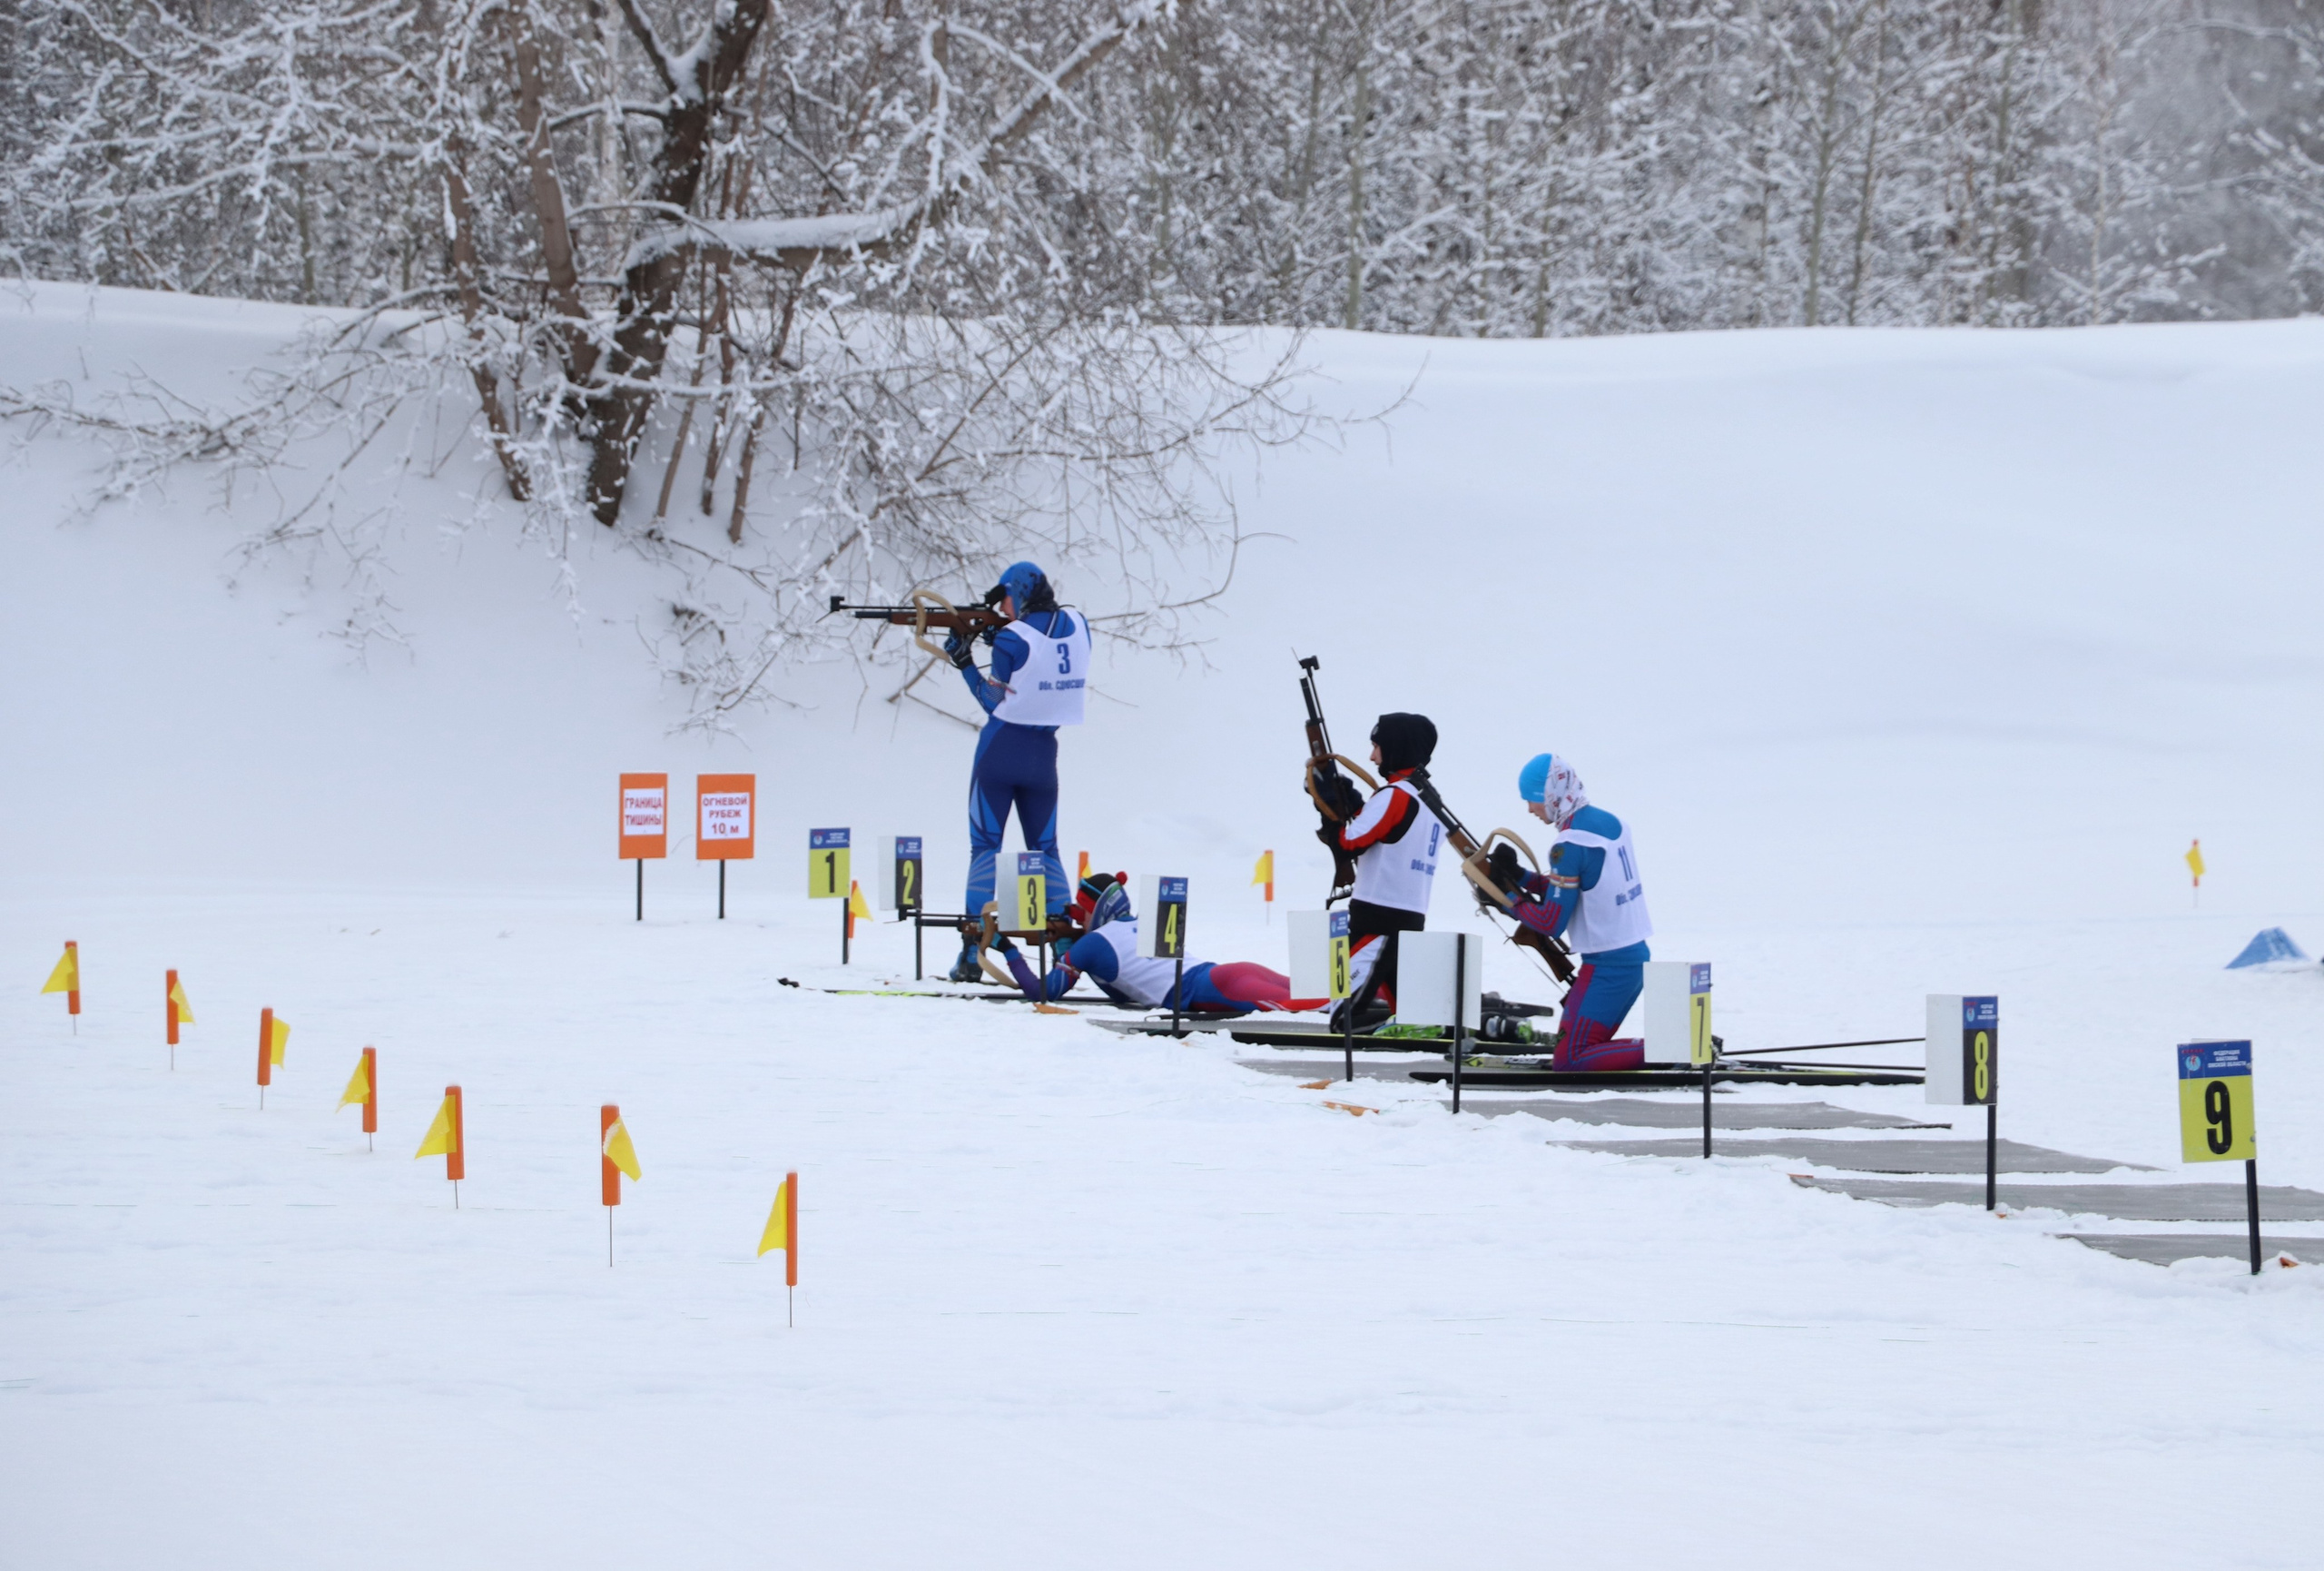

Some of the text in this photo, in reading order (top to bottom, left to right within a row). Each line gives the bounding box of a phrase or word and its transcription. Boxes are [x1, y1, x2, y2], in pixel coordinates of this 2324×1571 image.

[1057, 643, 1070, 674] 3
[625, 797, 663, 809] ГРАНИЦА
[625, 815, 662, 825] ТИШИНЫ
[703, 795, 748, 806] ОГНЕВОЙ
[709, 809, 742, 818] РУБЕЖ
[712, 823, 725, 835] 10
[1428, 823, 1440, 856] 9
[825, 851, 835, 894] 1
[902, 859, 915, 905] 2
[1618, 845, 1633, 882] 11
[1027, 877, 1038, 925] 3
[1164, 904, 1177, 954] 4
[1336, 940, 1344, 994] 5
[1697, 997, 1705, 1058] 7
[1974, 1031, 1989, 1100] 8
[2205, 1081, 2232, 1154] 9
